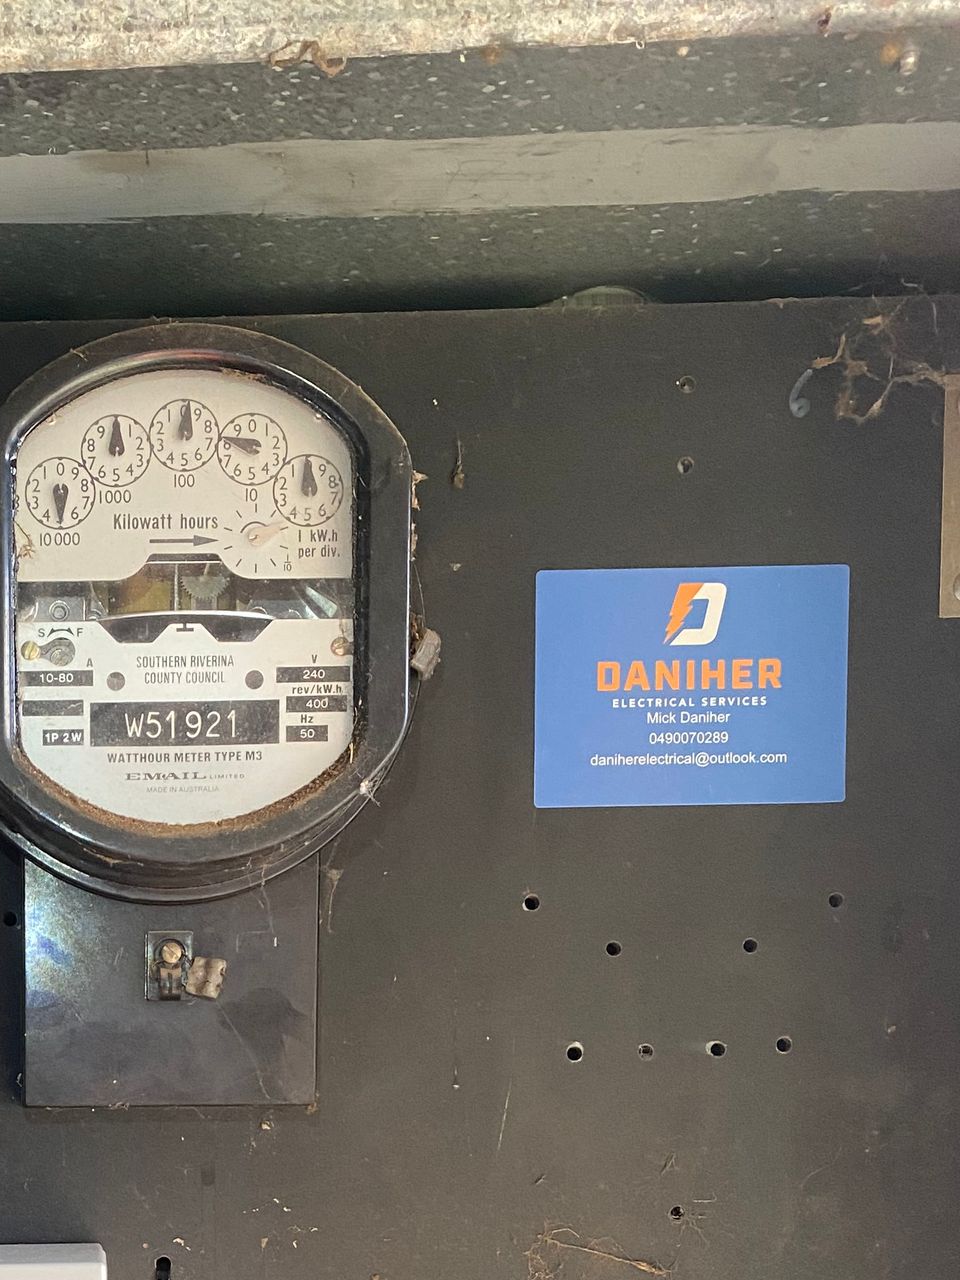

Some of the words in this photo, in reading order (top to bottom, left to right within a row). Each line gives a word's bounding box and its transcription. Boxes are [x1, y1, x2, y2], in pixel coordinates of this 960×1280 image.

[173, 473, 195, 488] 100
[99, 489, 132, 504] 1000
[245, 487, 258, 502] 10
[113, 513, 173, 530] Kilowatt
[180, 513, 219, 530] hours
[310, 530, 338, 543] kW.h
[298, 546, 317, 561] per
[320, 543, 341, 559] div.
[38, 628, 46, 638] S
[76, 628, 84, 638] F
[86, 658, 94, 668] A
[136, 656, 187, 668] SOUTHERN
[190, 655, 235, 668] RIVERINA
[311, 654, 318, 664] V
[39, 672, 74, 684] 10-80
[144, 672, 182, 685] COUNTY
[185, 671, 226, 684] COUNCIL
[302, 669, 326, 680] 240
[596, 658, 782, 692] DANIHER
[291, 684, 343, 695] rev/kW.h
[305, 698, 329, 709] 400
[612, 697, 695, 709] ELECTRICAL
[701, 696, 767, 707] SERVICES
[124, 710, 237, 739] W51921
[301, 714, 314, 724] Hz
[647, 711, 677, 725] Mick
[680, 711, 731, 724] Daniher
[45, 732, 59, 744] 1P
[300, 728, 316, 739] 50
[649, 732, 729, 745] 0490070289
[107, 752, 171, 764] WATTHOUR
[174, 751, 211, 763] METER
[215, 751, 242, 763] TYPE
[245, 750, 263, 761] M3
[590, 752, 787, 767] daniherelectrical@outlook.com
[125, 771, 207, 781] EMAIL
[179, 785, 220, 793] AUSTRALIA
